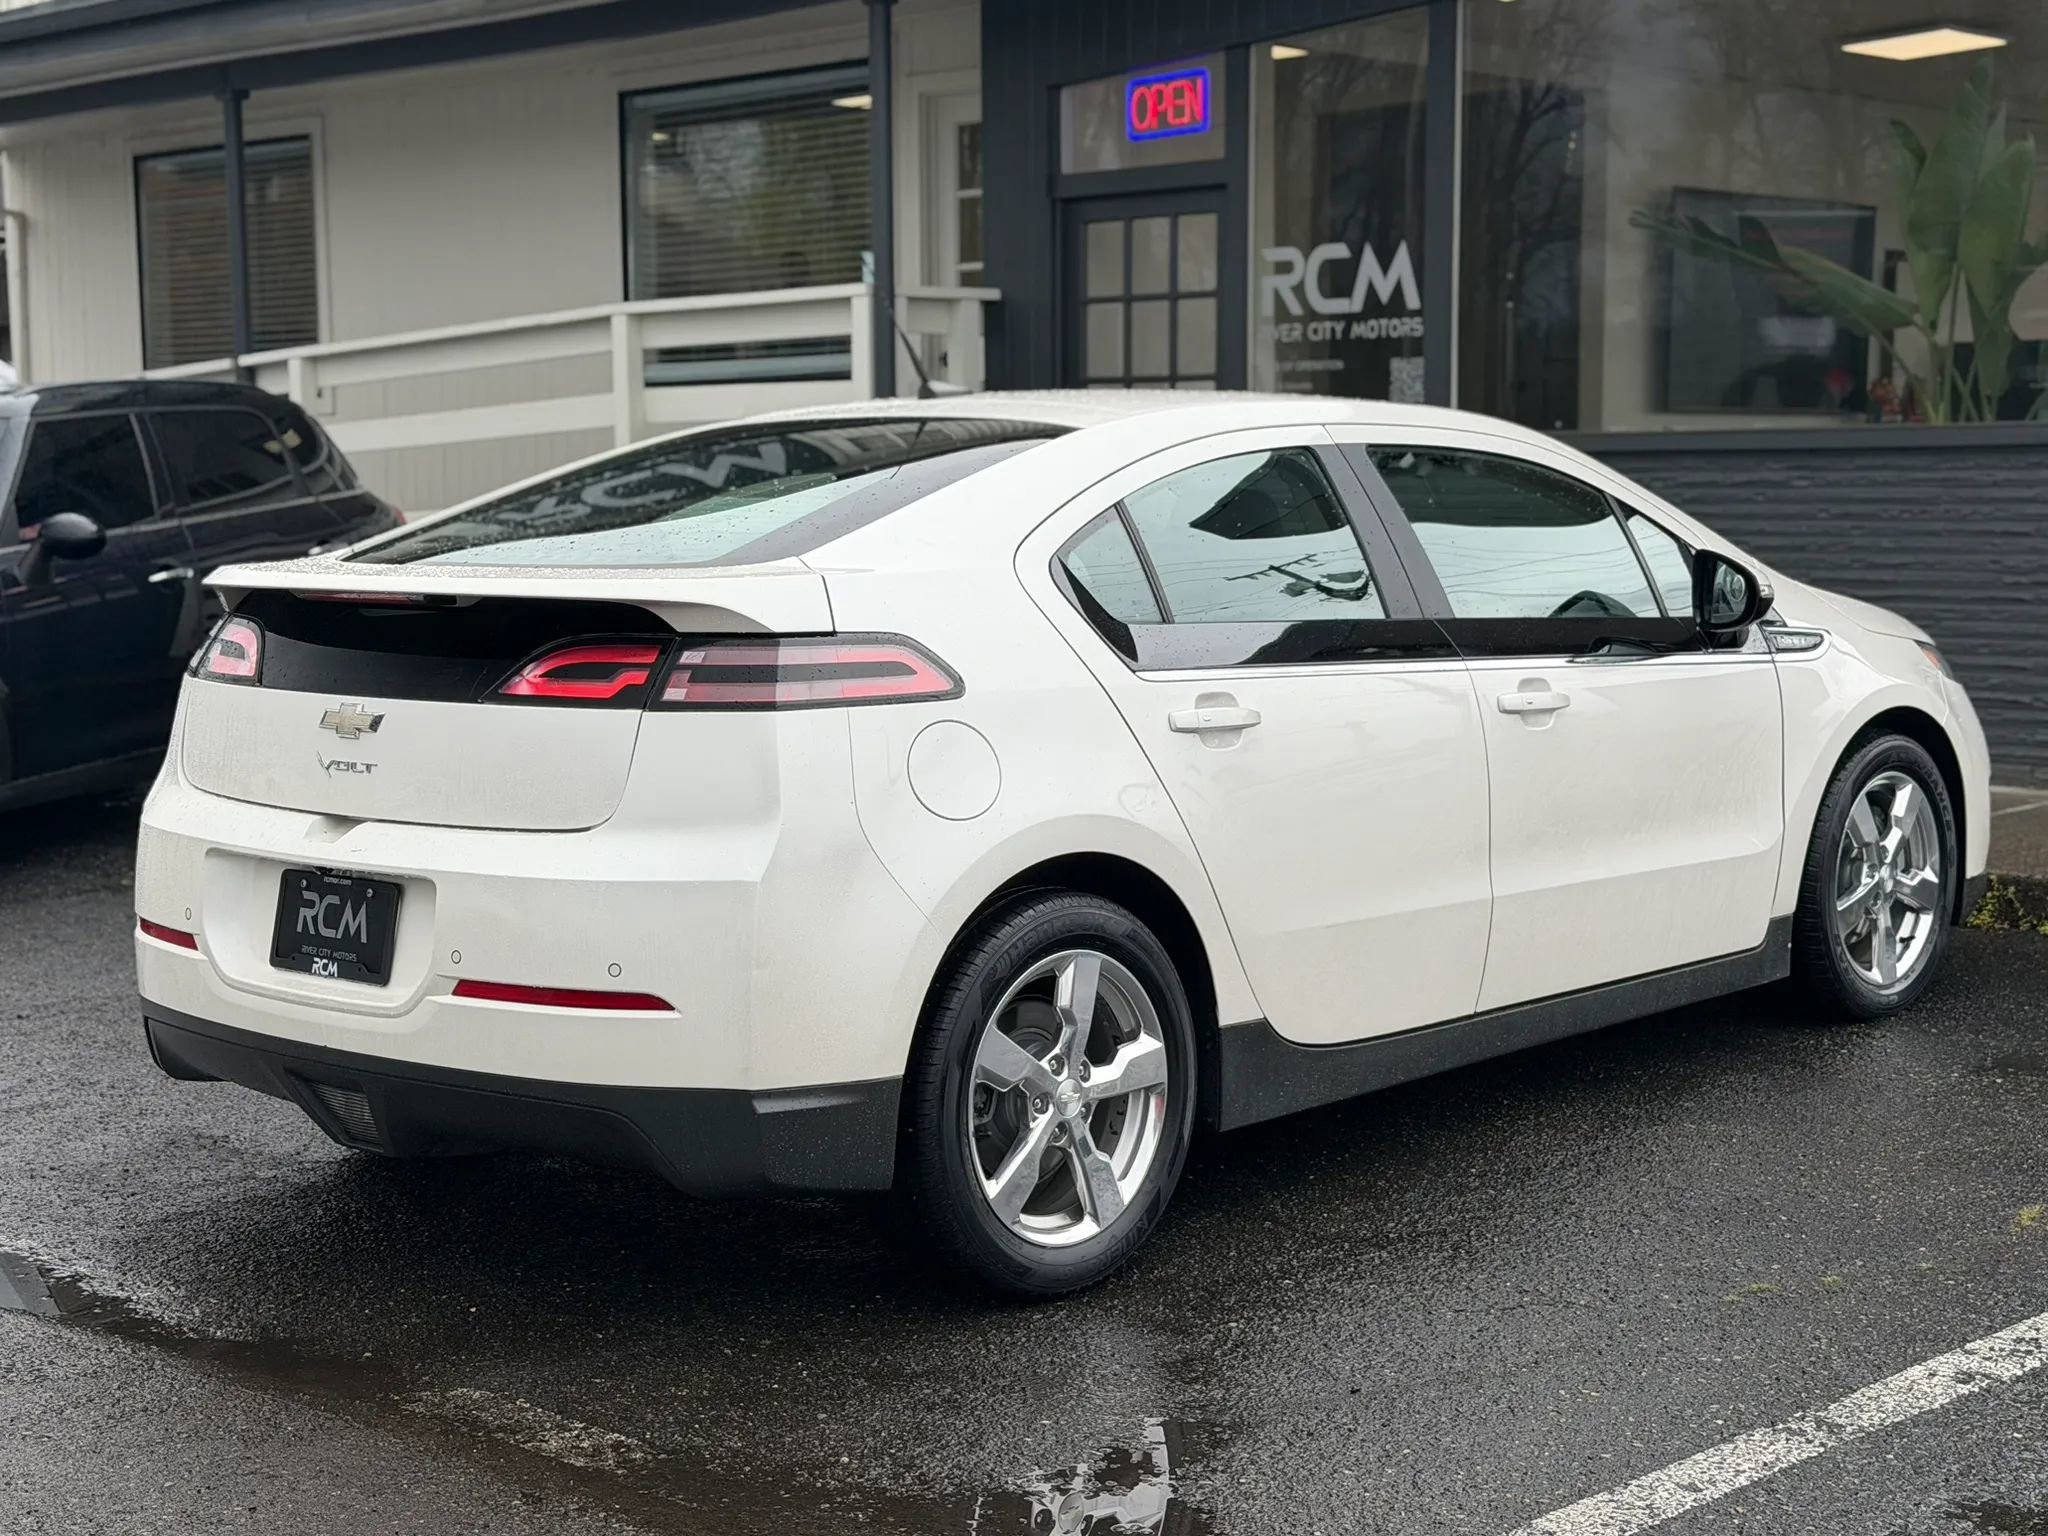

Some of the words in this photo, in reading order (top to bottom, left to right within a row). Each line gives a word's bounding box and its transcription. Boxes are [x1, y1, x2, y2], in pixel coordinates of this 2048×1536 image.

[1131, 76, 1204, 132] OPEN
[1261, 239, 1422, 316] RCM
[1307, 321, 1346, 341] CITY
[1349, 317, 1425, 340] MOTORS
[316, 751, 379, 778] VOLT
[296, 890, 368, 944] RCM
[301, 945, 318, 956] RIVER
[318, 947, 331, 958] CITY
[333, 950, 358, 962] MOTORS
[311, 957, 338, 977] RCM
